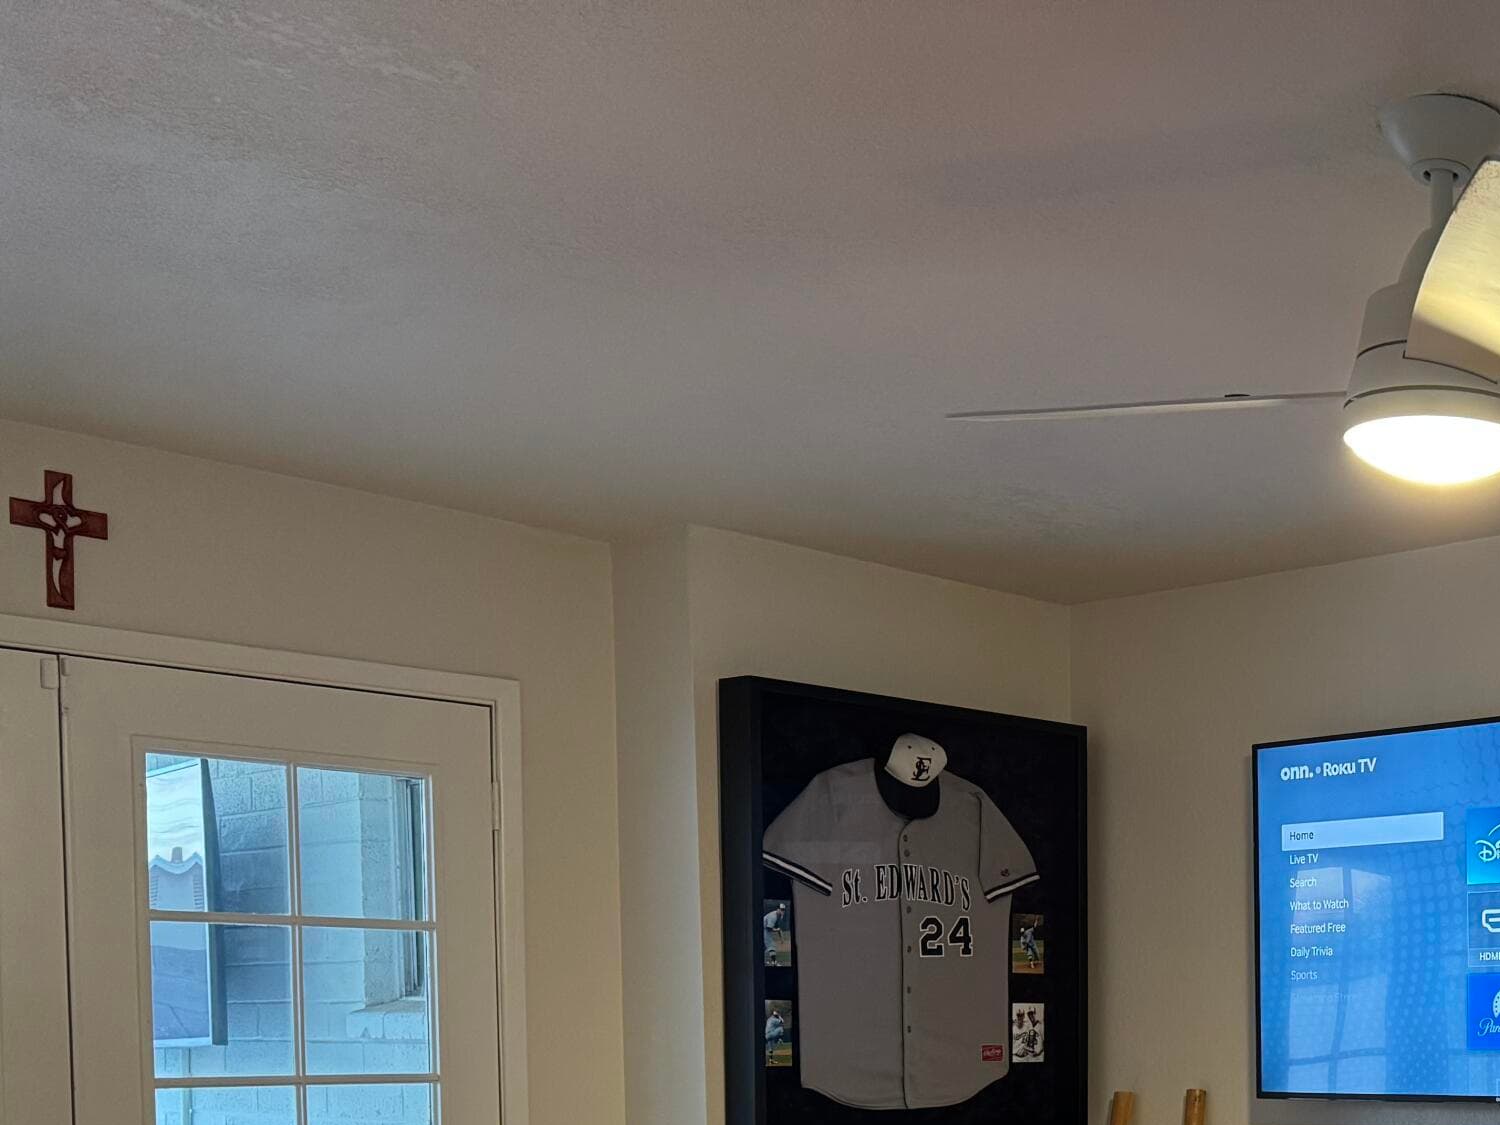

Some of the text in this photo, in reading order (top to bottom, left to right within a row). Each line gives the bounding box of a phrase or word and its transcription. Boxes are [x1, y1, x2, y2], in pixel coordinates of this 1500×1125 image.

[1280, 757, 1378, 781] onn. Roku TV
[1289, 830, 1315, 841] Home
[1289, 853, 1319, 865] Live TV
[874, 863, 971, 912] EDWARD'S
[1289, 876, 1317, 888] Search
[1289, 898, 1349, 911] What to Watch
[1290, 922, 1347, 934] Featured Free
[919, 915, 974, 958] 24
[1290, 946, 1333, 959] Daily Trivia
[1479, 951, 1500, 961] HDMI
[1291, 970, 1318, 981] Sports
